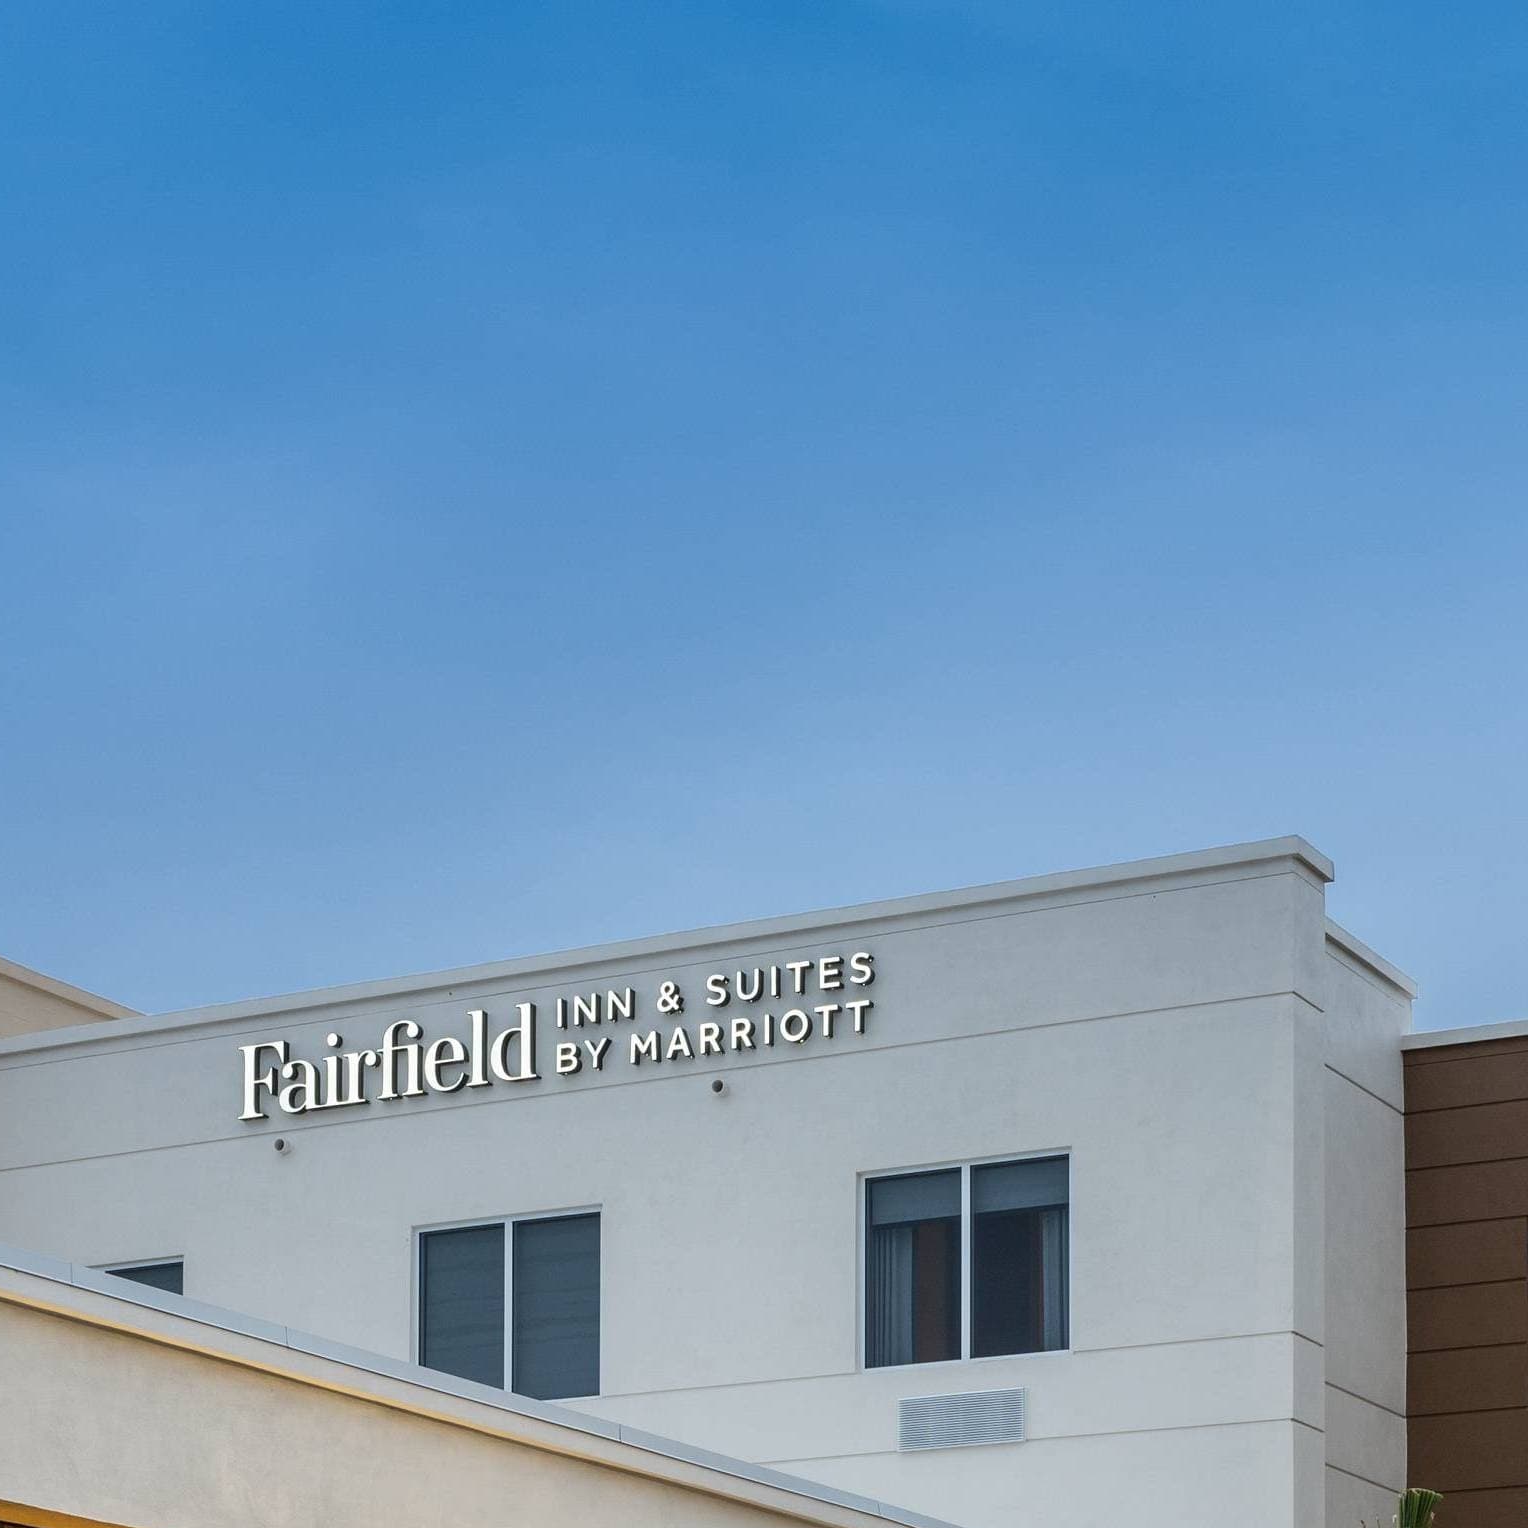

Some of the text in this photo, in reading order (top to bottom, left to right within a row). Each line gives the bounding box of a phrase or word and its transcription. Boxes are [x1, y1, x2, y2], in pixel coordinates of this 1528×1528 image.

[557, 952, 874, 1030] INN & SUITES
[238, 1003, 541, 1120] Fairfield
[556, 1000, 871, 1075] BY MARRIOTT
